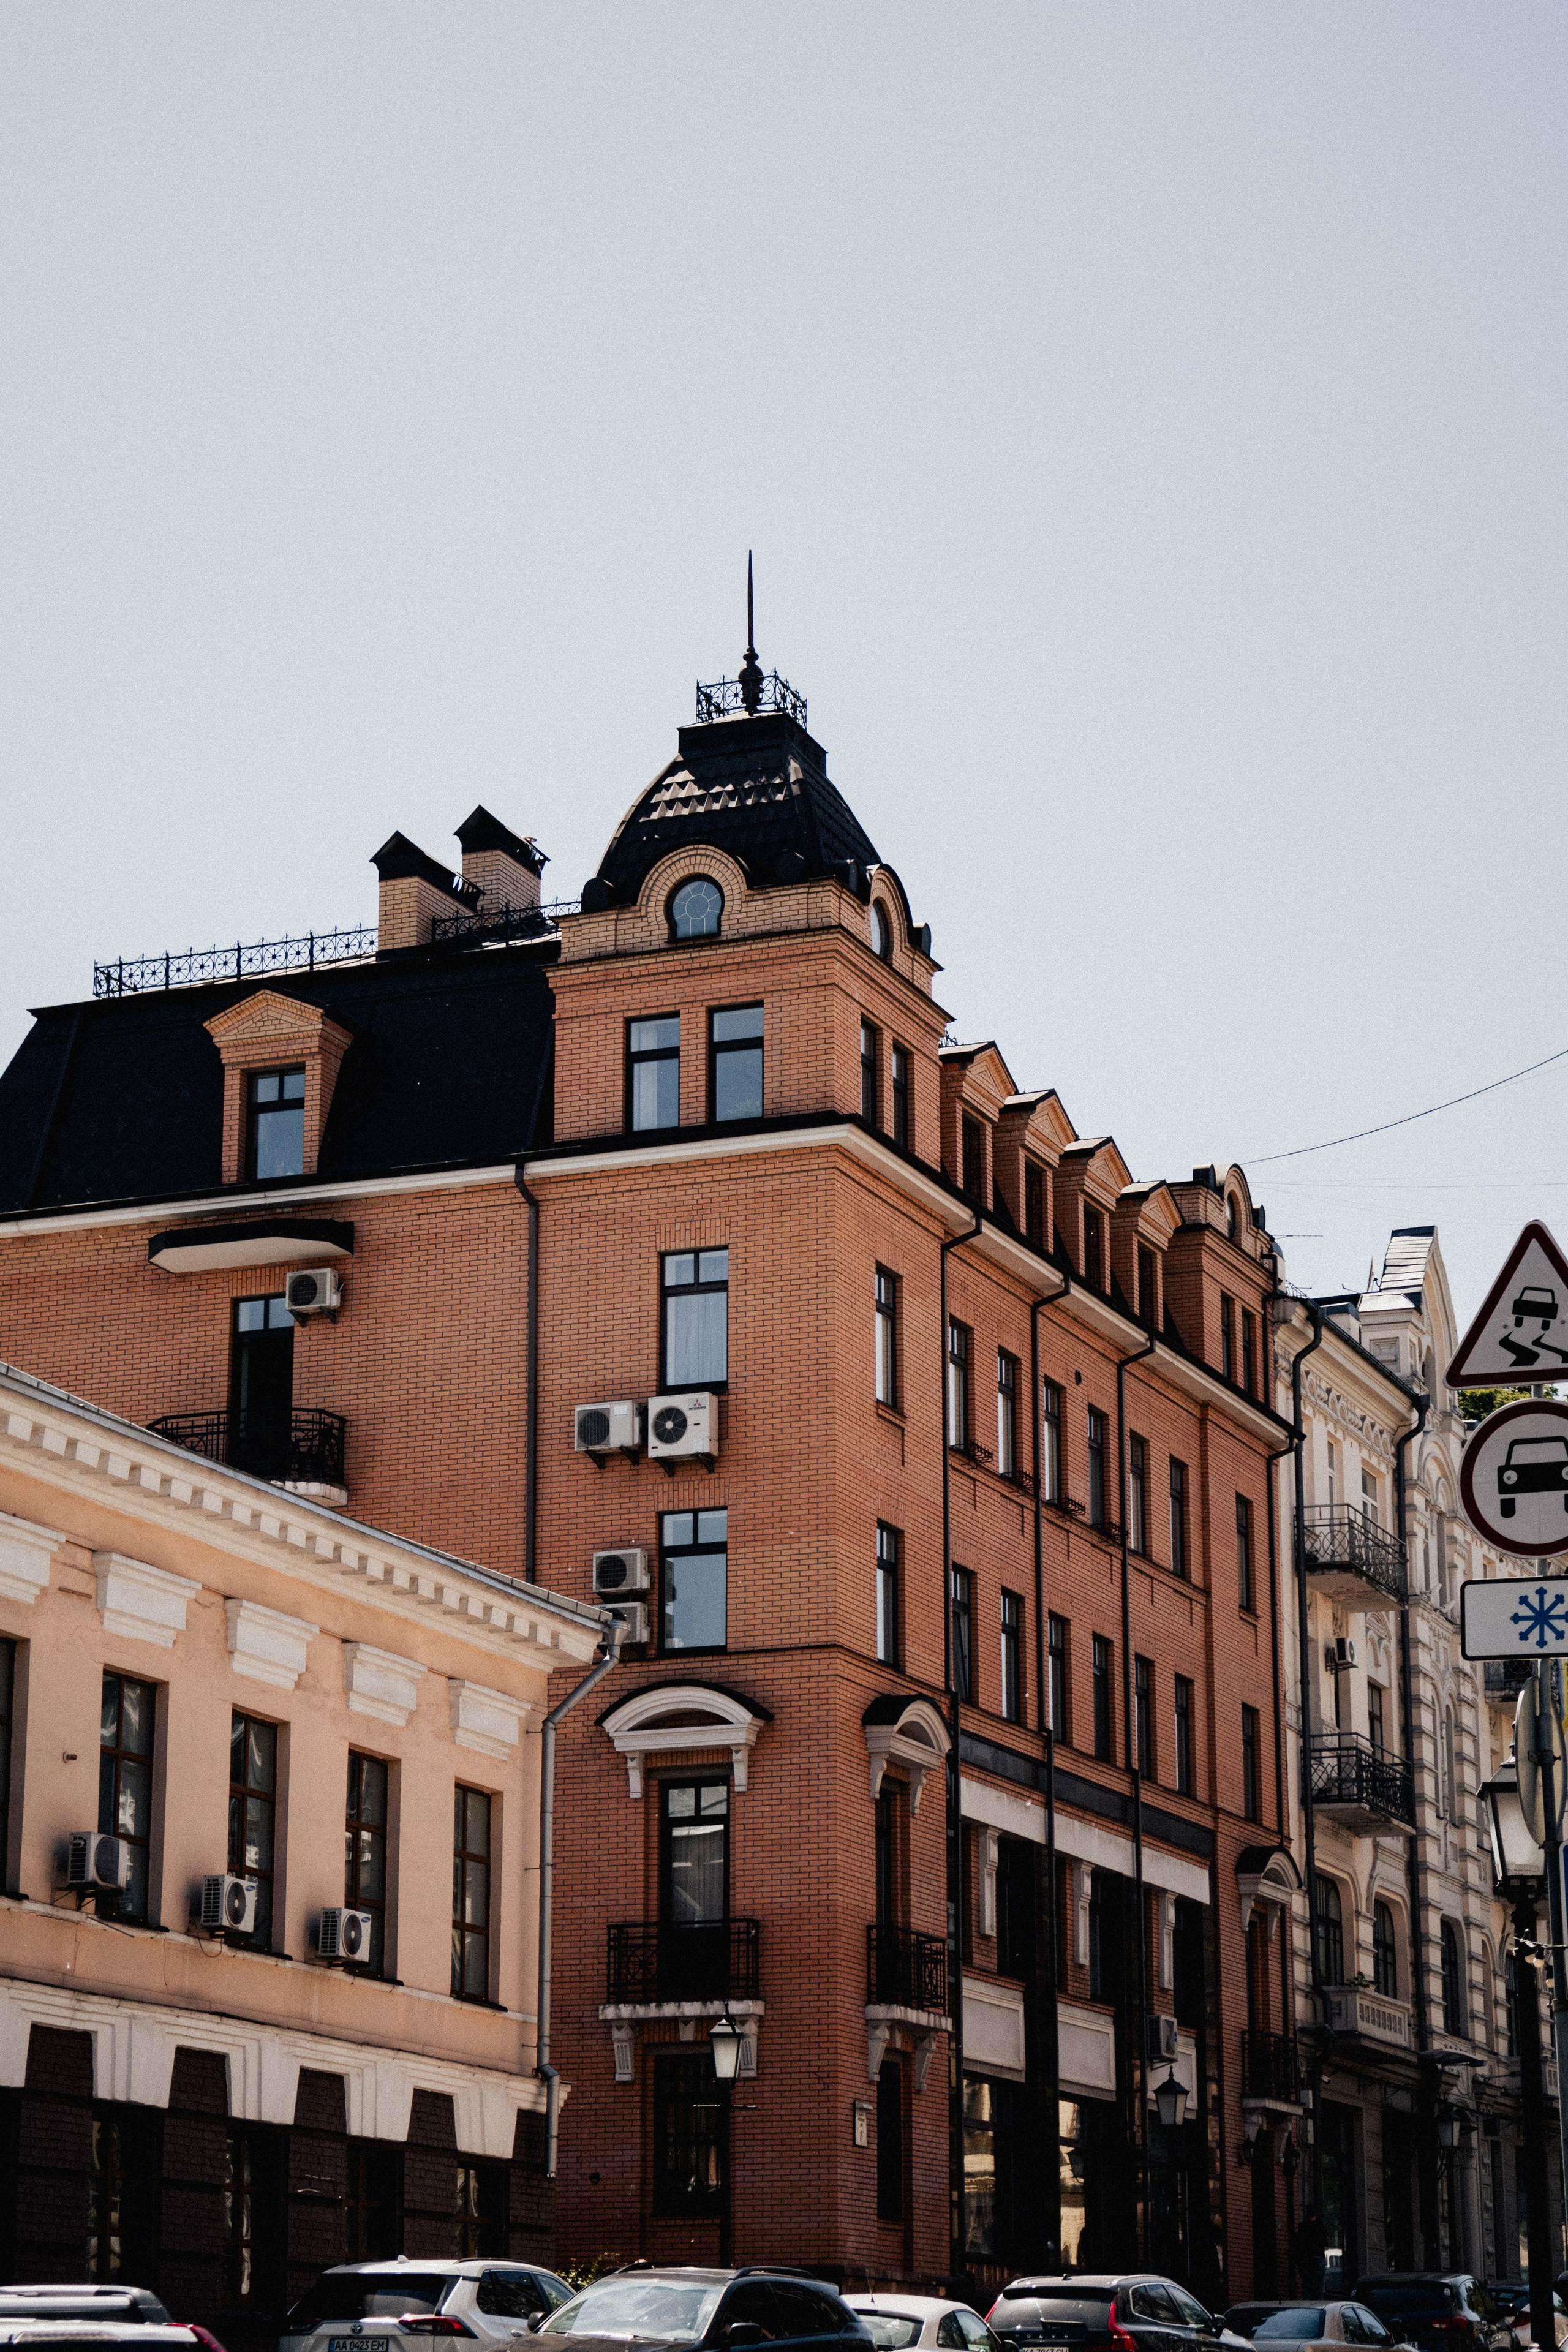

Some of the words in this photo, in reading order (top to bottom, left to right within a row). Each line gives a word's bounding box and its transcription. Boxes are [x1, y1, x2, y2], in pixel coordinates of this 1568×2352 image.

[335, 2340, 347, 2351] AA
[349, 2340, 369, 2351] 0423
[371, 2340, 385, 2351] EM
